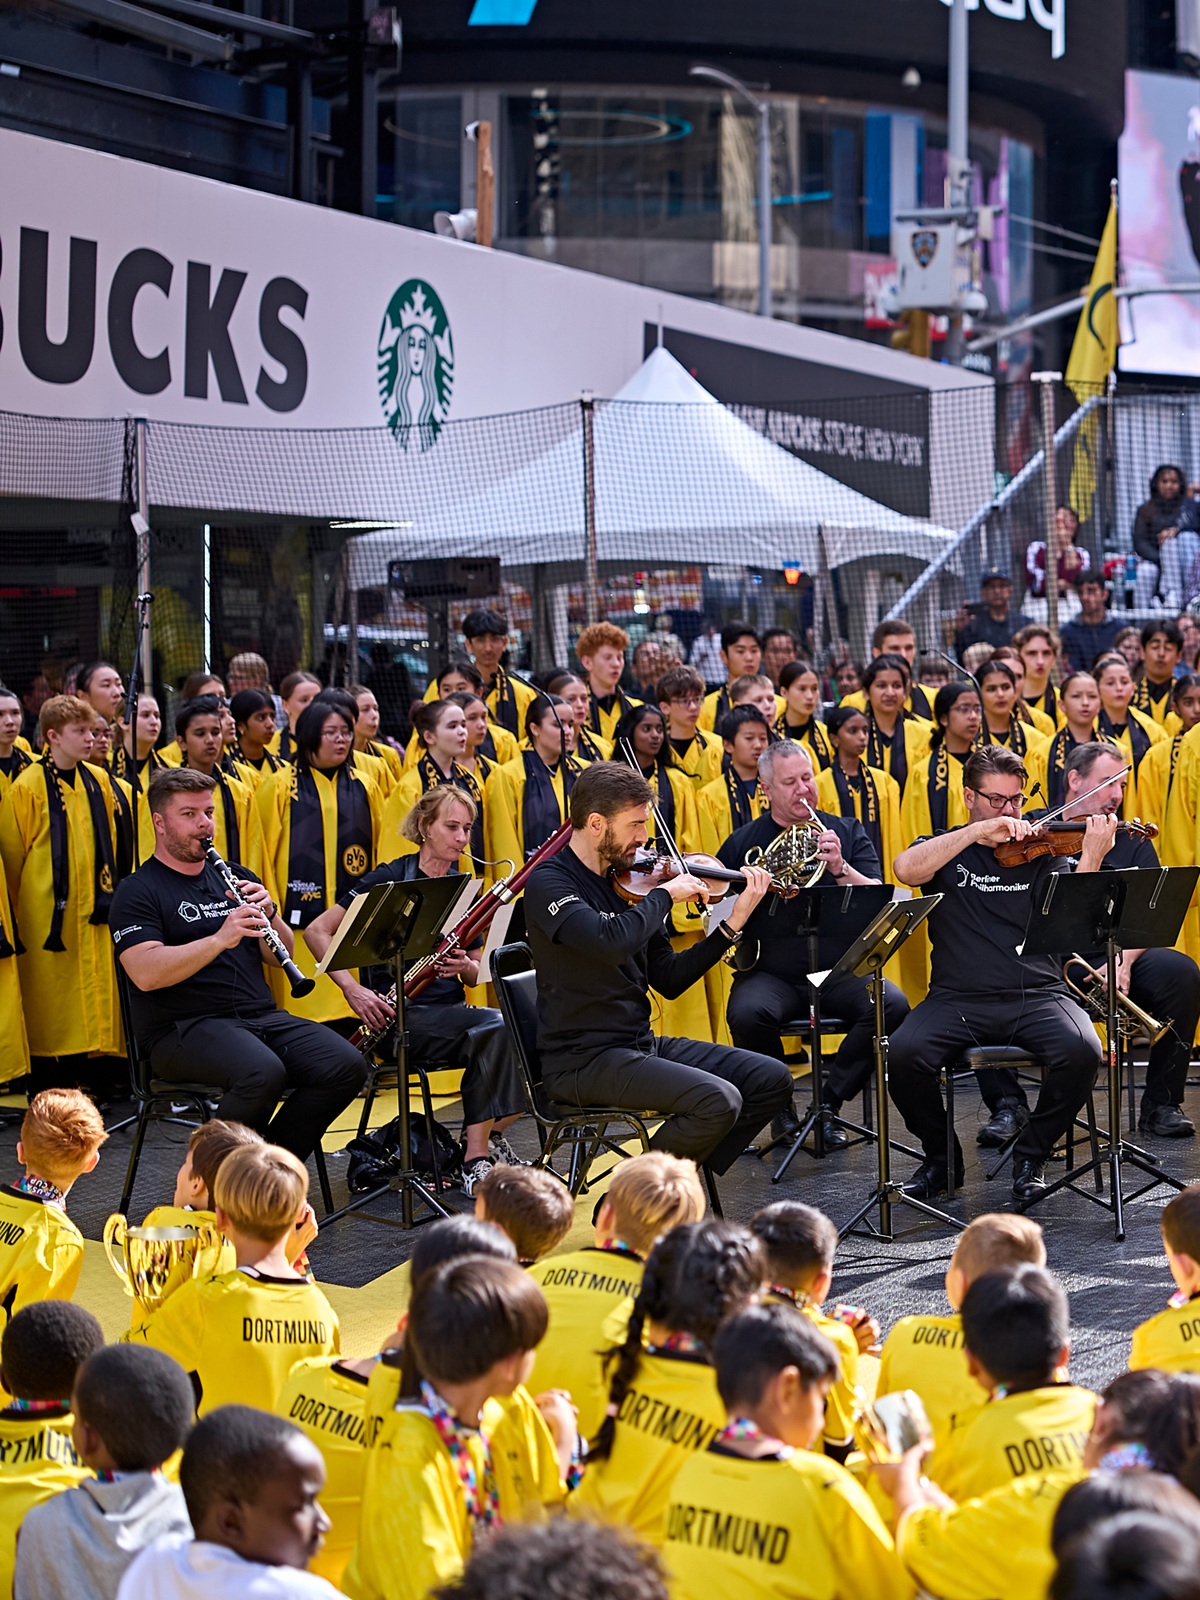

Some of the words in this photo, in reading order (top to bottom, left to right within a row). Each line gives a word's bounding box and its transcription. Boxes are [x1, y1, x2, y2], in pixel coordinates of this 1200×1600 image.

[0, 225, 309, 414] UCKS
[346, 848, 365, 868] BVB
[970, 873, 1000, 884] Berliner
[969, 880, 1030, 893] Philharmoniker
[300, 891, 322, 902] NYC
[198, 900, 228, 911] Berliner
[26, 1183, 43, 1195] USA
[30, 1177, 48, 1189] CUP
[242, 1316, 327, 1345] DORTMUND
[912, 1325, 965, 1349] DORT
